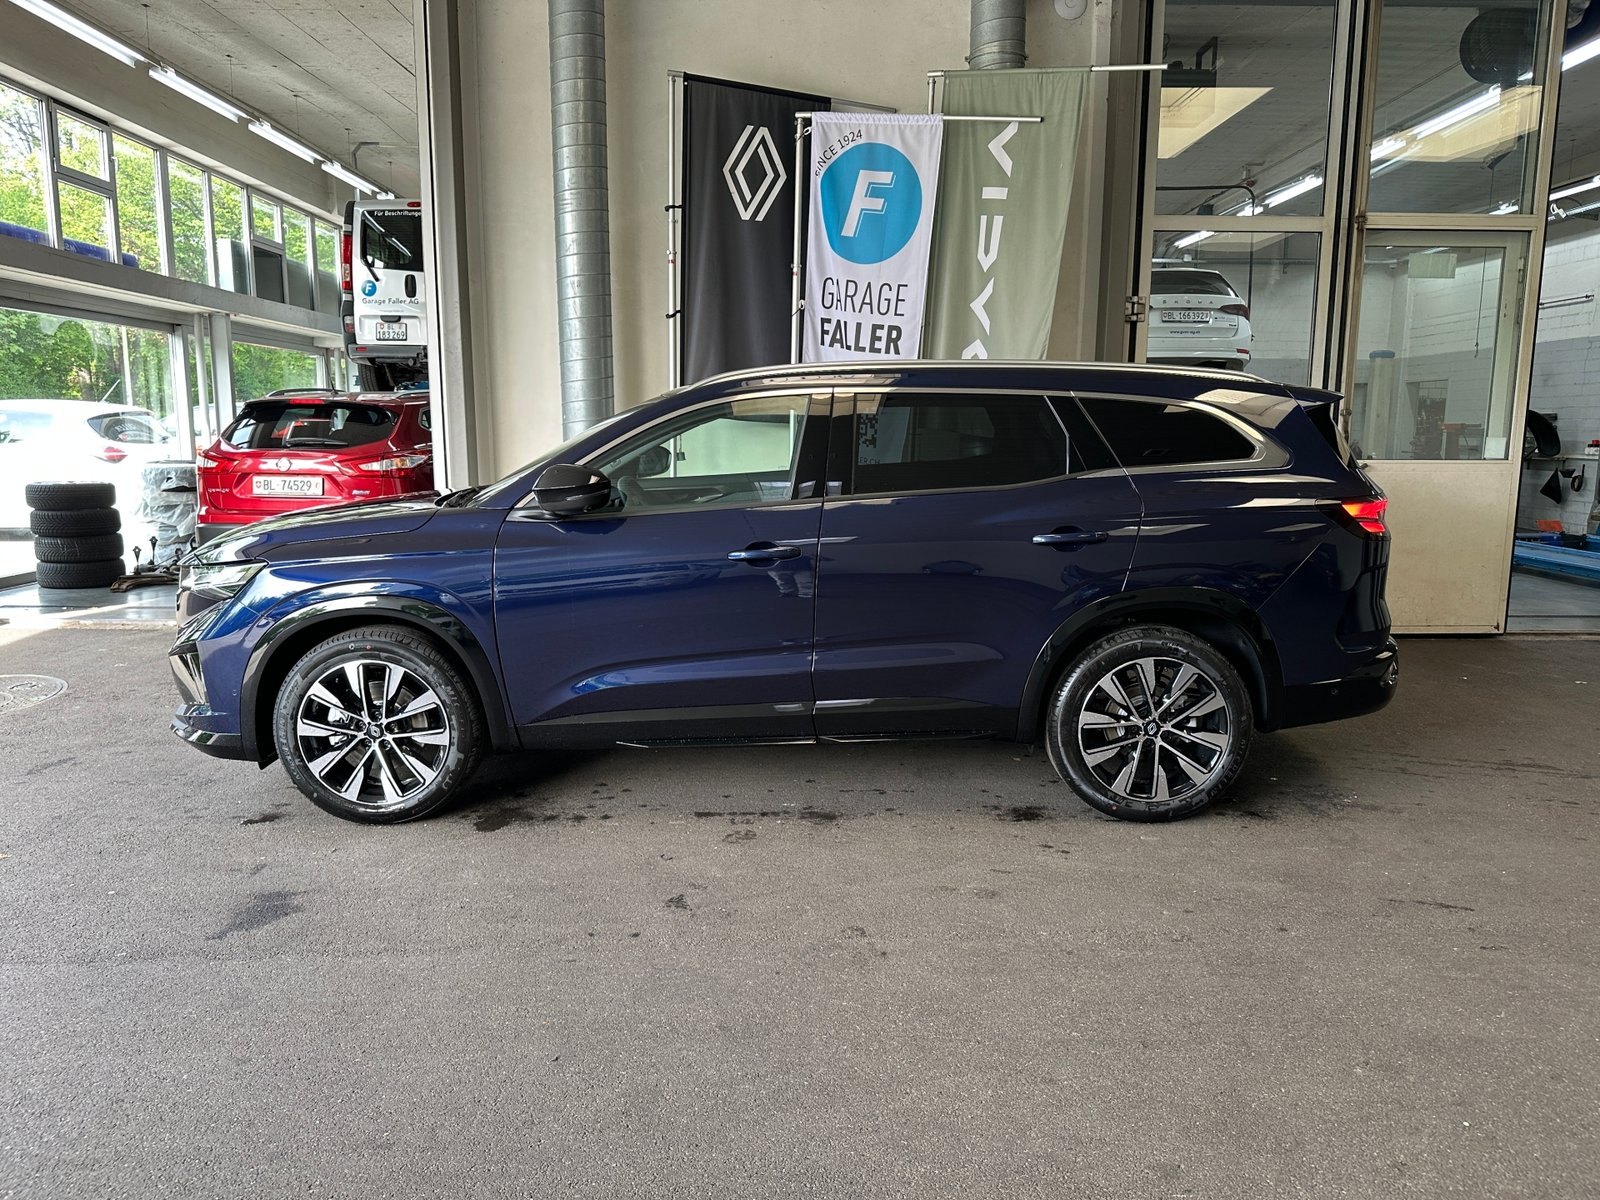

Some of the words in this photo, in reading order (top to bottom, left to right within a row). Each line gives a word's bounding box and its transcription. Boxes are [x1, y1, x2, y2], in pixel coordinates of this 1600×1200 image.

[815, 145, 838, 176] SINCE
[837, 129, 863, 150] 1924
[841, 169, 896, 237] F
[821, 277, 908, 317] GARAGE
[820, 317, 903, 355] FALLER
[263, 480, 275, 491] BL
[281, 479, 312, 492] 74529
